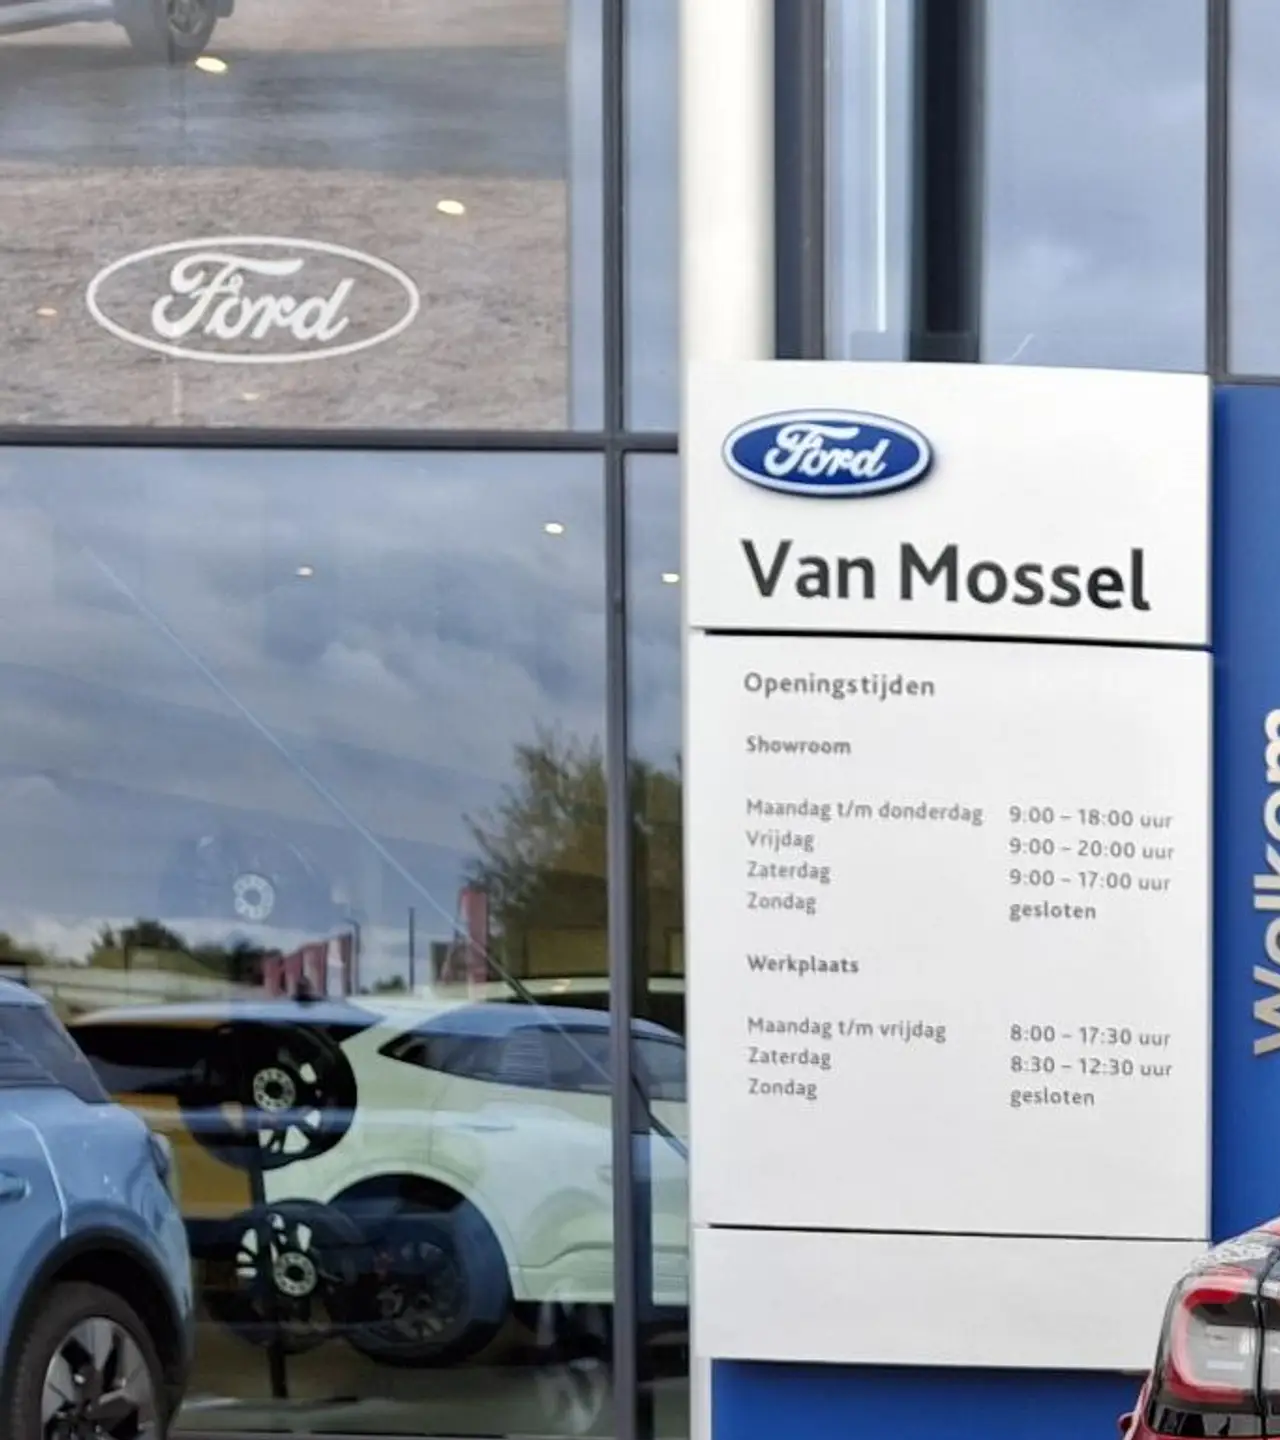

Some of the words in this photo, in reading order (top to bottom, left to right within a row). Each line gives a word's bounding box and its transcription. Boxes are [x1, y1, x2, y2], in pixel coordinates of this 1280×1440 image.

[152, 252, 353, 342] Ford
[764, 422, 888, 478] Ford
[740, 538, 875, 601] Van
[900, 543, 1152, 611] Mossel
[744, 671, 935, 701] Openingstijden
[746, 736, 851, 755] Showroom
[746, 798, 831, 821] Maandag
[837, 800, 872, 818] t/m
[879, 803, 984, 825] donderdag
[1009, 806, 1054, 825] 9:00
[1078, 808, 1133, 827] 18:00
[1140, 813, 1173, 828] uur
[746, 831, 815, 853] Vrijdag
[1009, 838, 1054, 856] 9:00
[1078, 840, 1135, 859] 20:00
[1143, 845, 1174, 860] uur
[747, 861, 831, 883] Zaterdag
[1009, 869, 1054, 888] 9:00
[1080, 871, 1131, 890] 17:00
[1138, 875, 1171, 891] uur
[747, 893, 817, 915] Zondag
[1009, 902, 1096, 921] gesloten
[747, 955, 859, 976] Werkplaats
[748, 1018, 831, 1039] Maandag
[838, 1020, 872, 1038] t/m
[880, 1021, 947, 1043] vrijdag
[1011, 1025, 1055, 1043] 8:00
[1080, 1028, 1131, 1047] 17:30
[1139, 1032, 1171, 1047] uur
[748, 1048, 831, 1069] Zaterdag
[1011, 1056, 1055, 1074] 8:30
[1080, 1058, 1133, 1077] 12:30
[1140, 1063, 1173, 1077] uur
[748, 1078, 818, 1099] Zondag
[1010, 1088, 1095, 1108] gesloten
